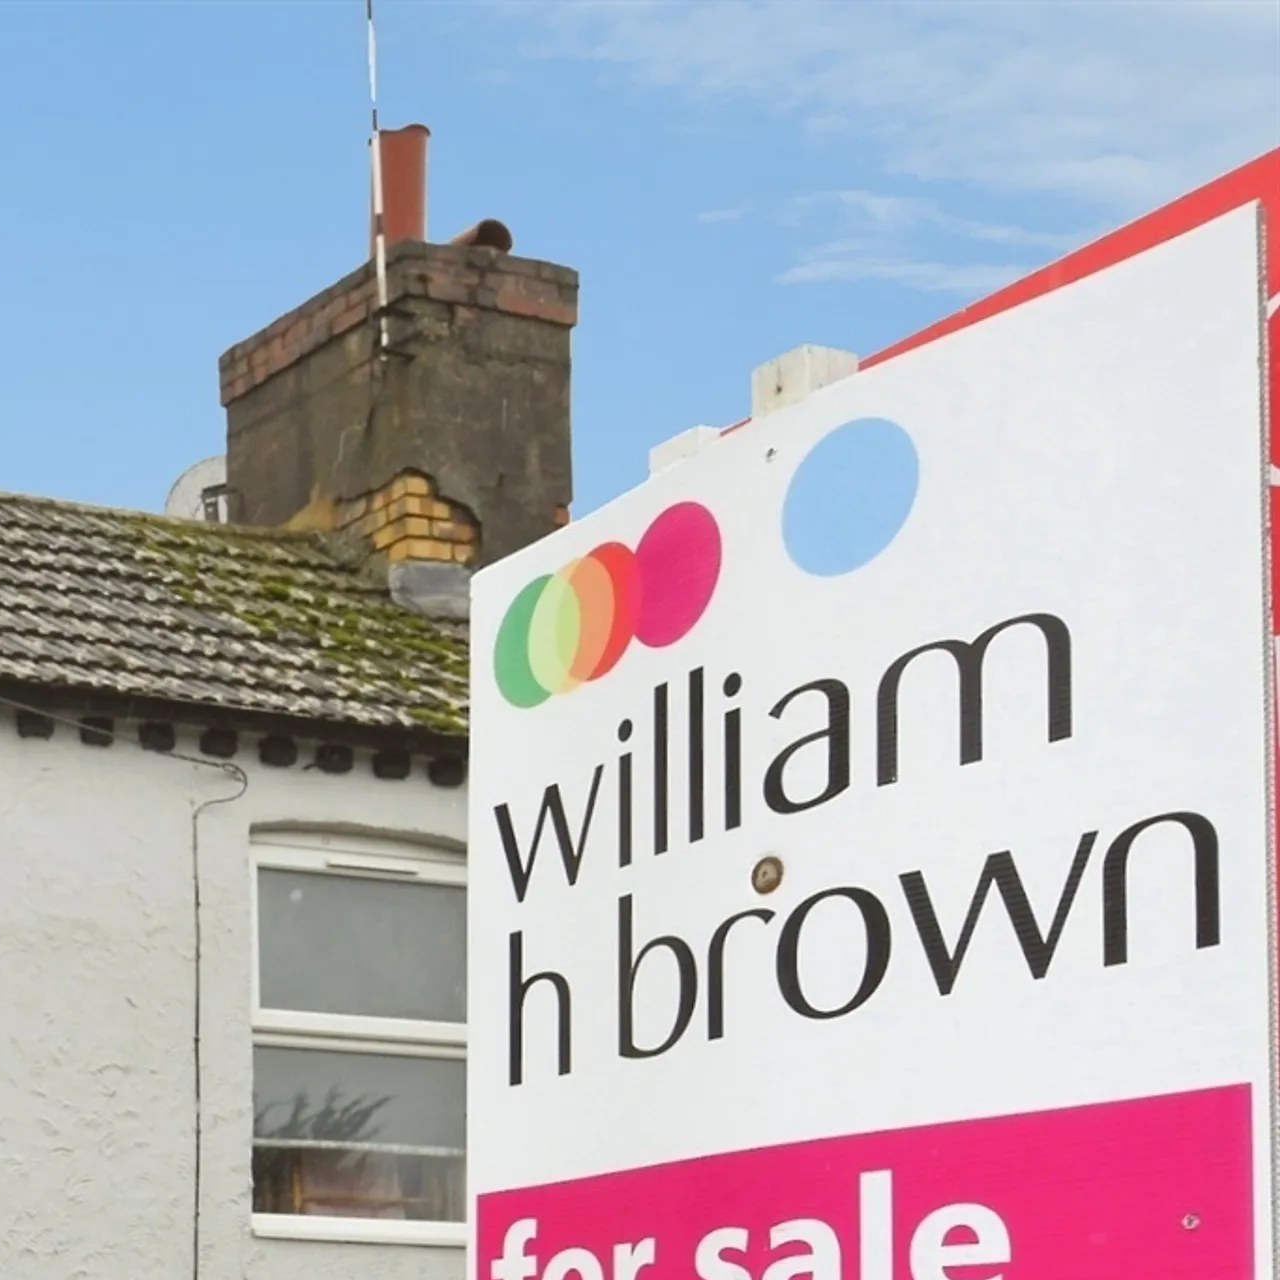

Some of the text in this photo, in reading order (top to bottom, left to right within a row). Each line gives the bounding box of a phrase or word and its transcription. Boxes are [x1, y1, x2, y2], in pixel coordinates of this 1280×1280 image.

[493, 611, 1073, 904] william
[508, 810, 1222, 1087] h brown
